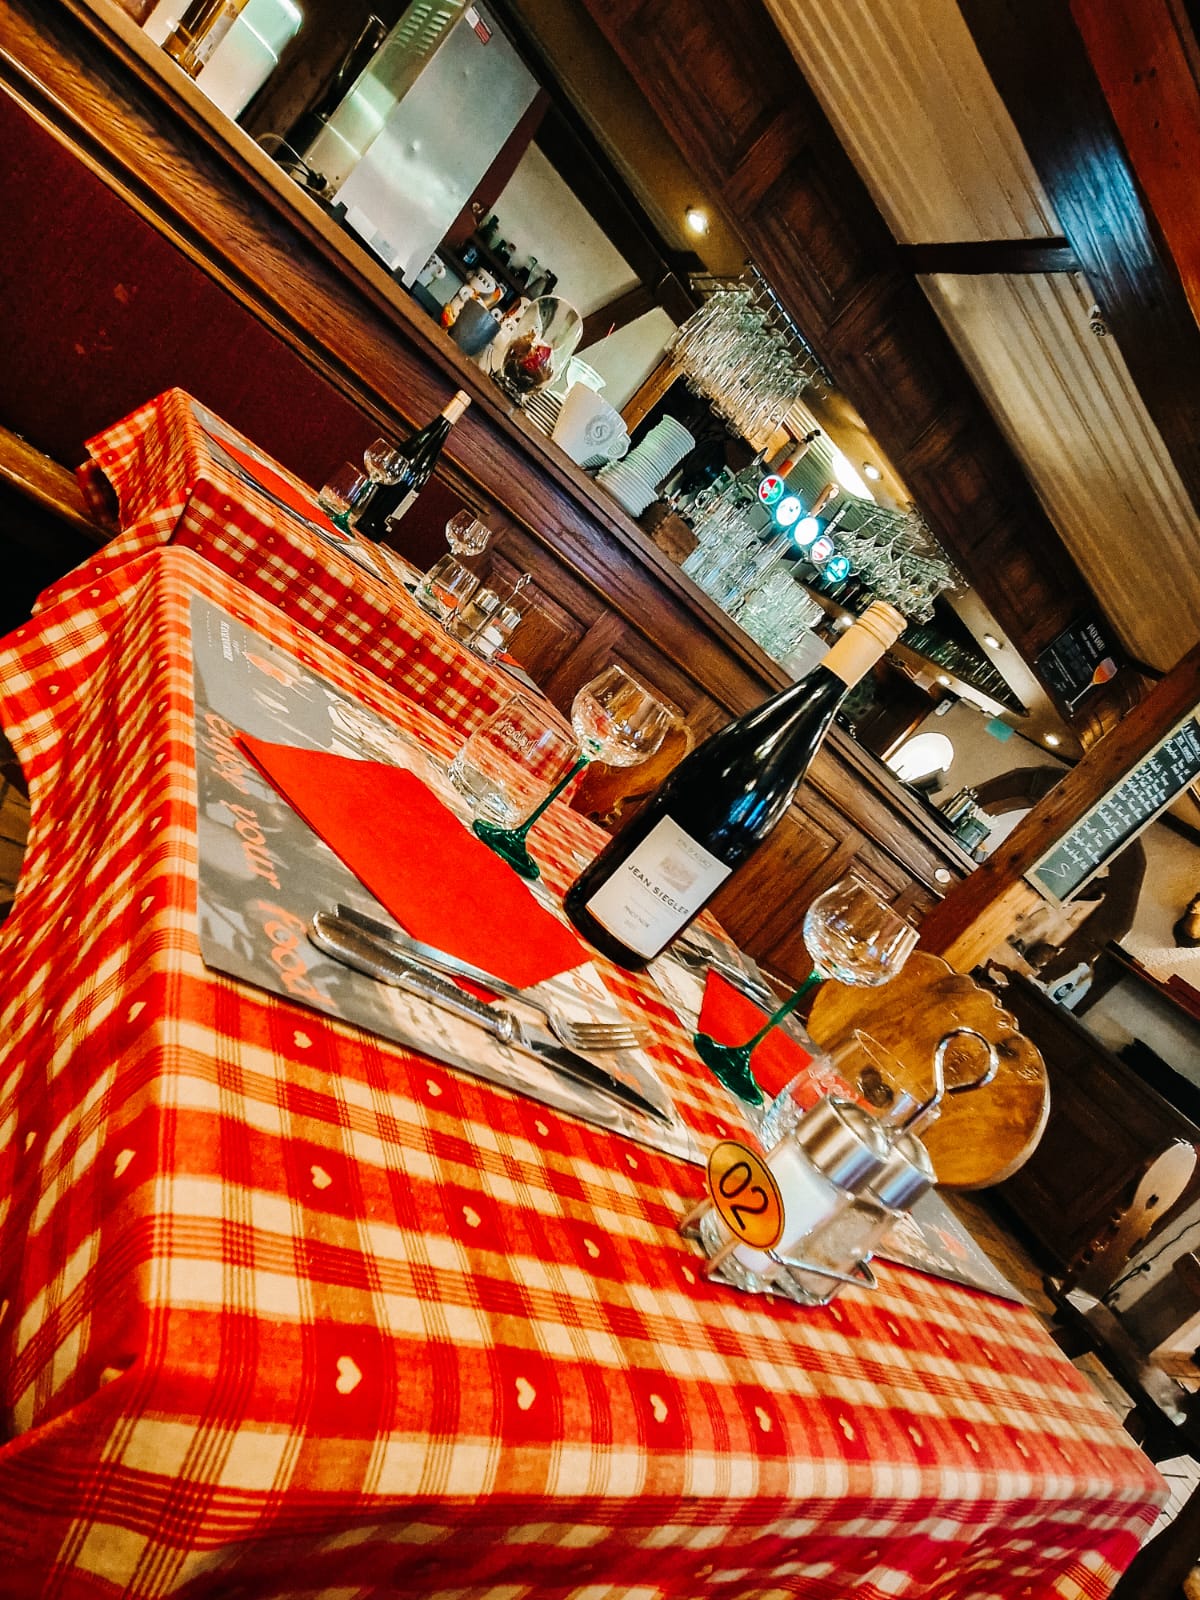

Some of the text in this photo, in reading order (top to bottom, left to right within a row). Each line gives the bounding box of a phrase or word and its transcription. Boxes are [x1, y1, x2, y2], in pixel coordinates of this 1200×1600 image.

[202, 713, 338, 1007] enjoy your food
[627, 864, 689, 915] JEAN SIEGLER
[719, 1161, 769, 1231] 02
